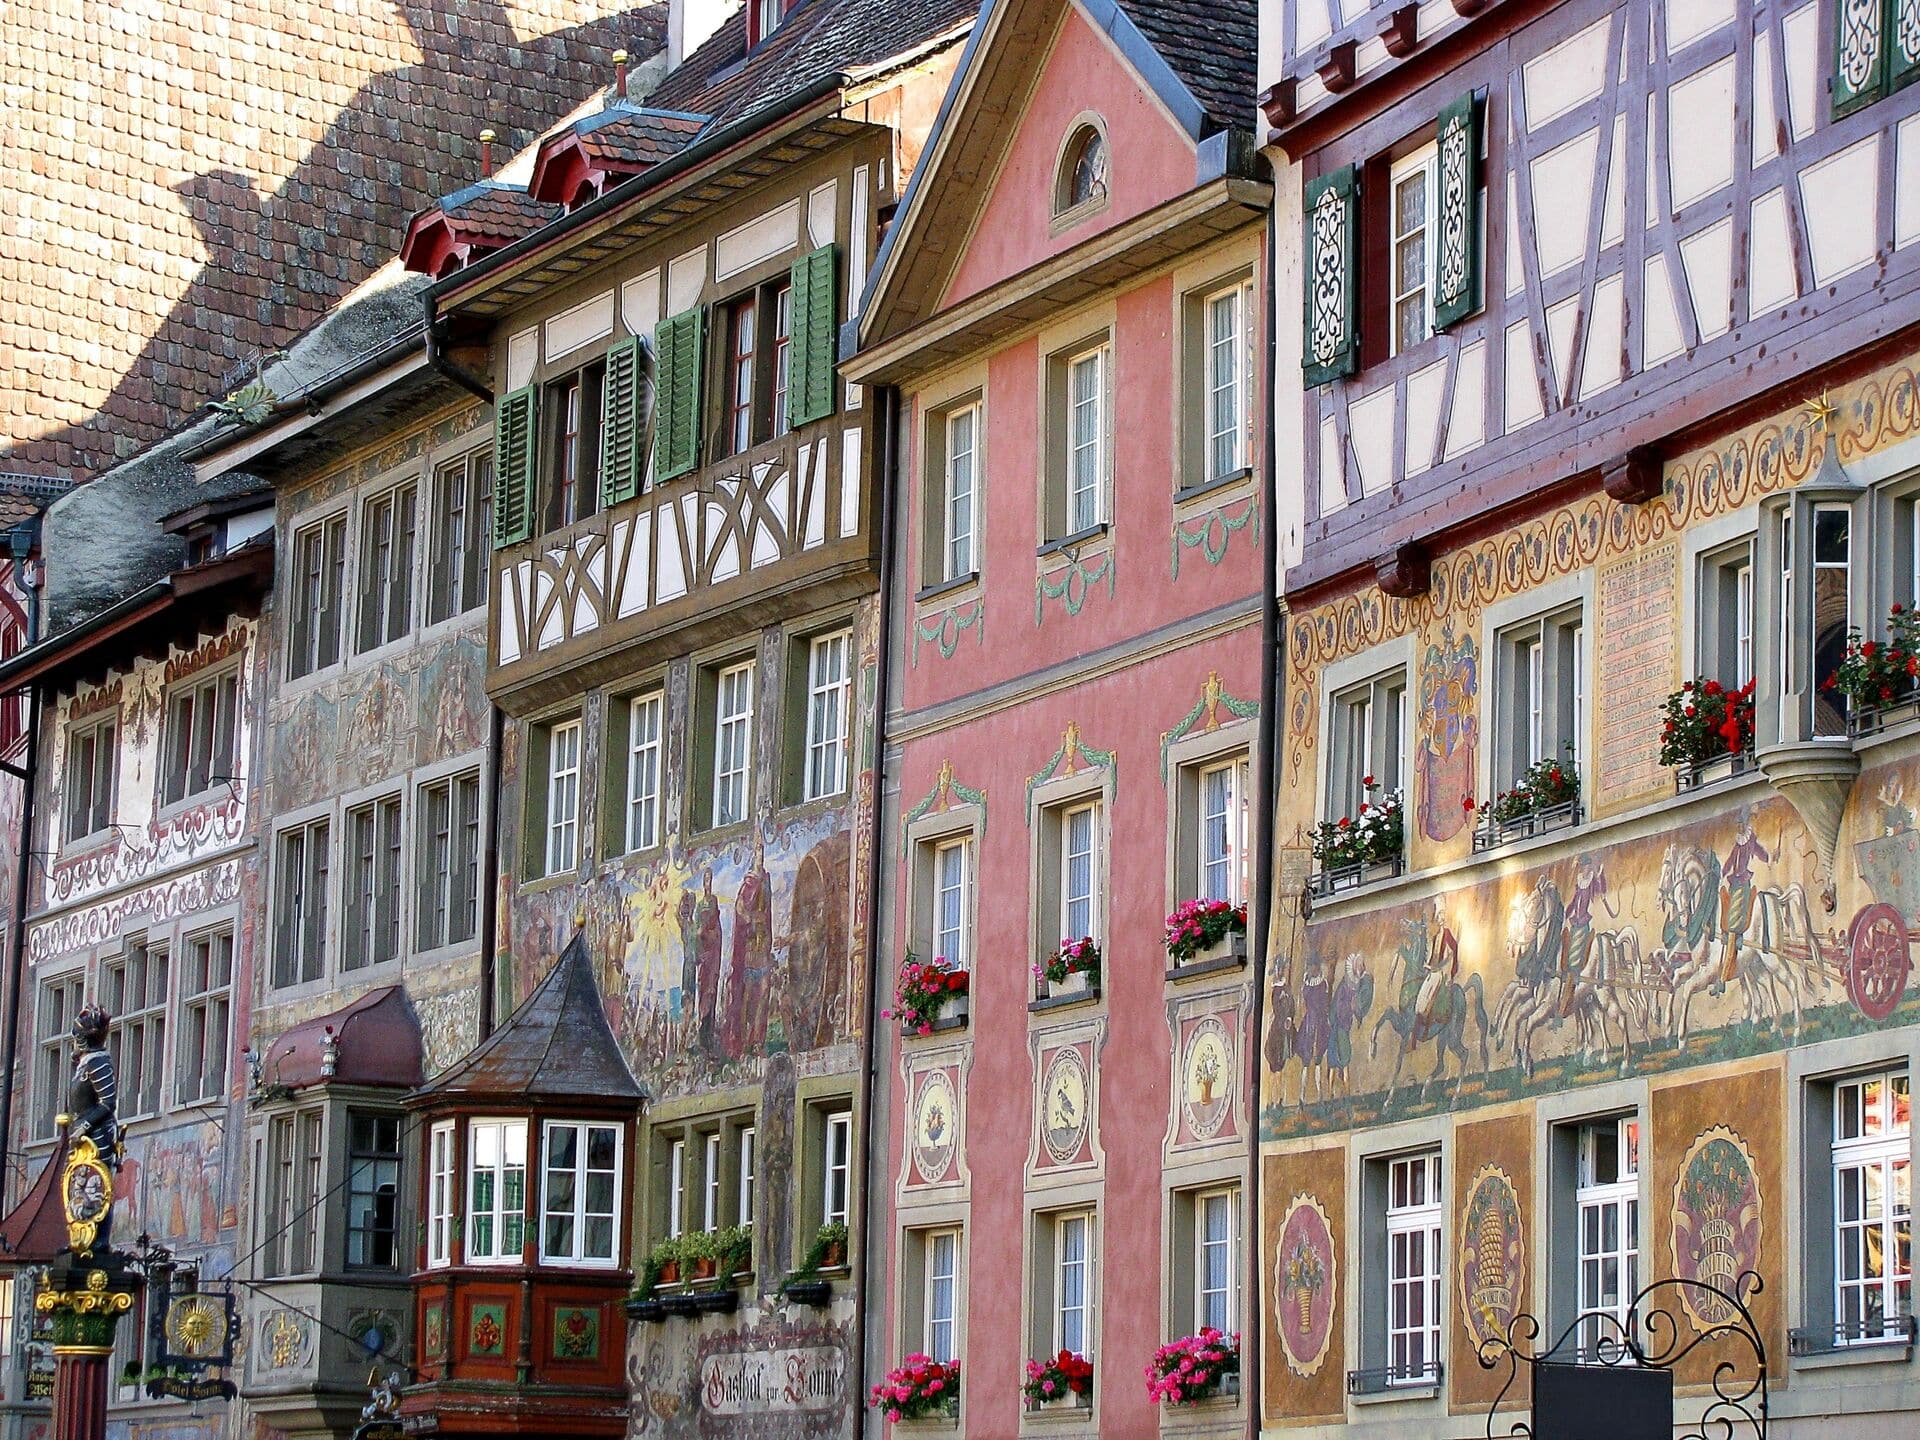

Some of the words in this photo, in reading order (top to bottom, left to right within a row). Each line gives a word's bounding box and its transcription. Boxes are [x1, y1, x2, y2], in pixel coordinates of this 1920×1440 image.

[707, 1360, 765, 1409] Gasthof
[766, 1387, 779, 1407] zur
[784, 1353, 840, 1404] Sonne
